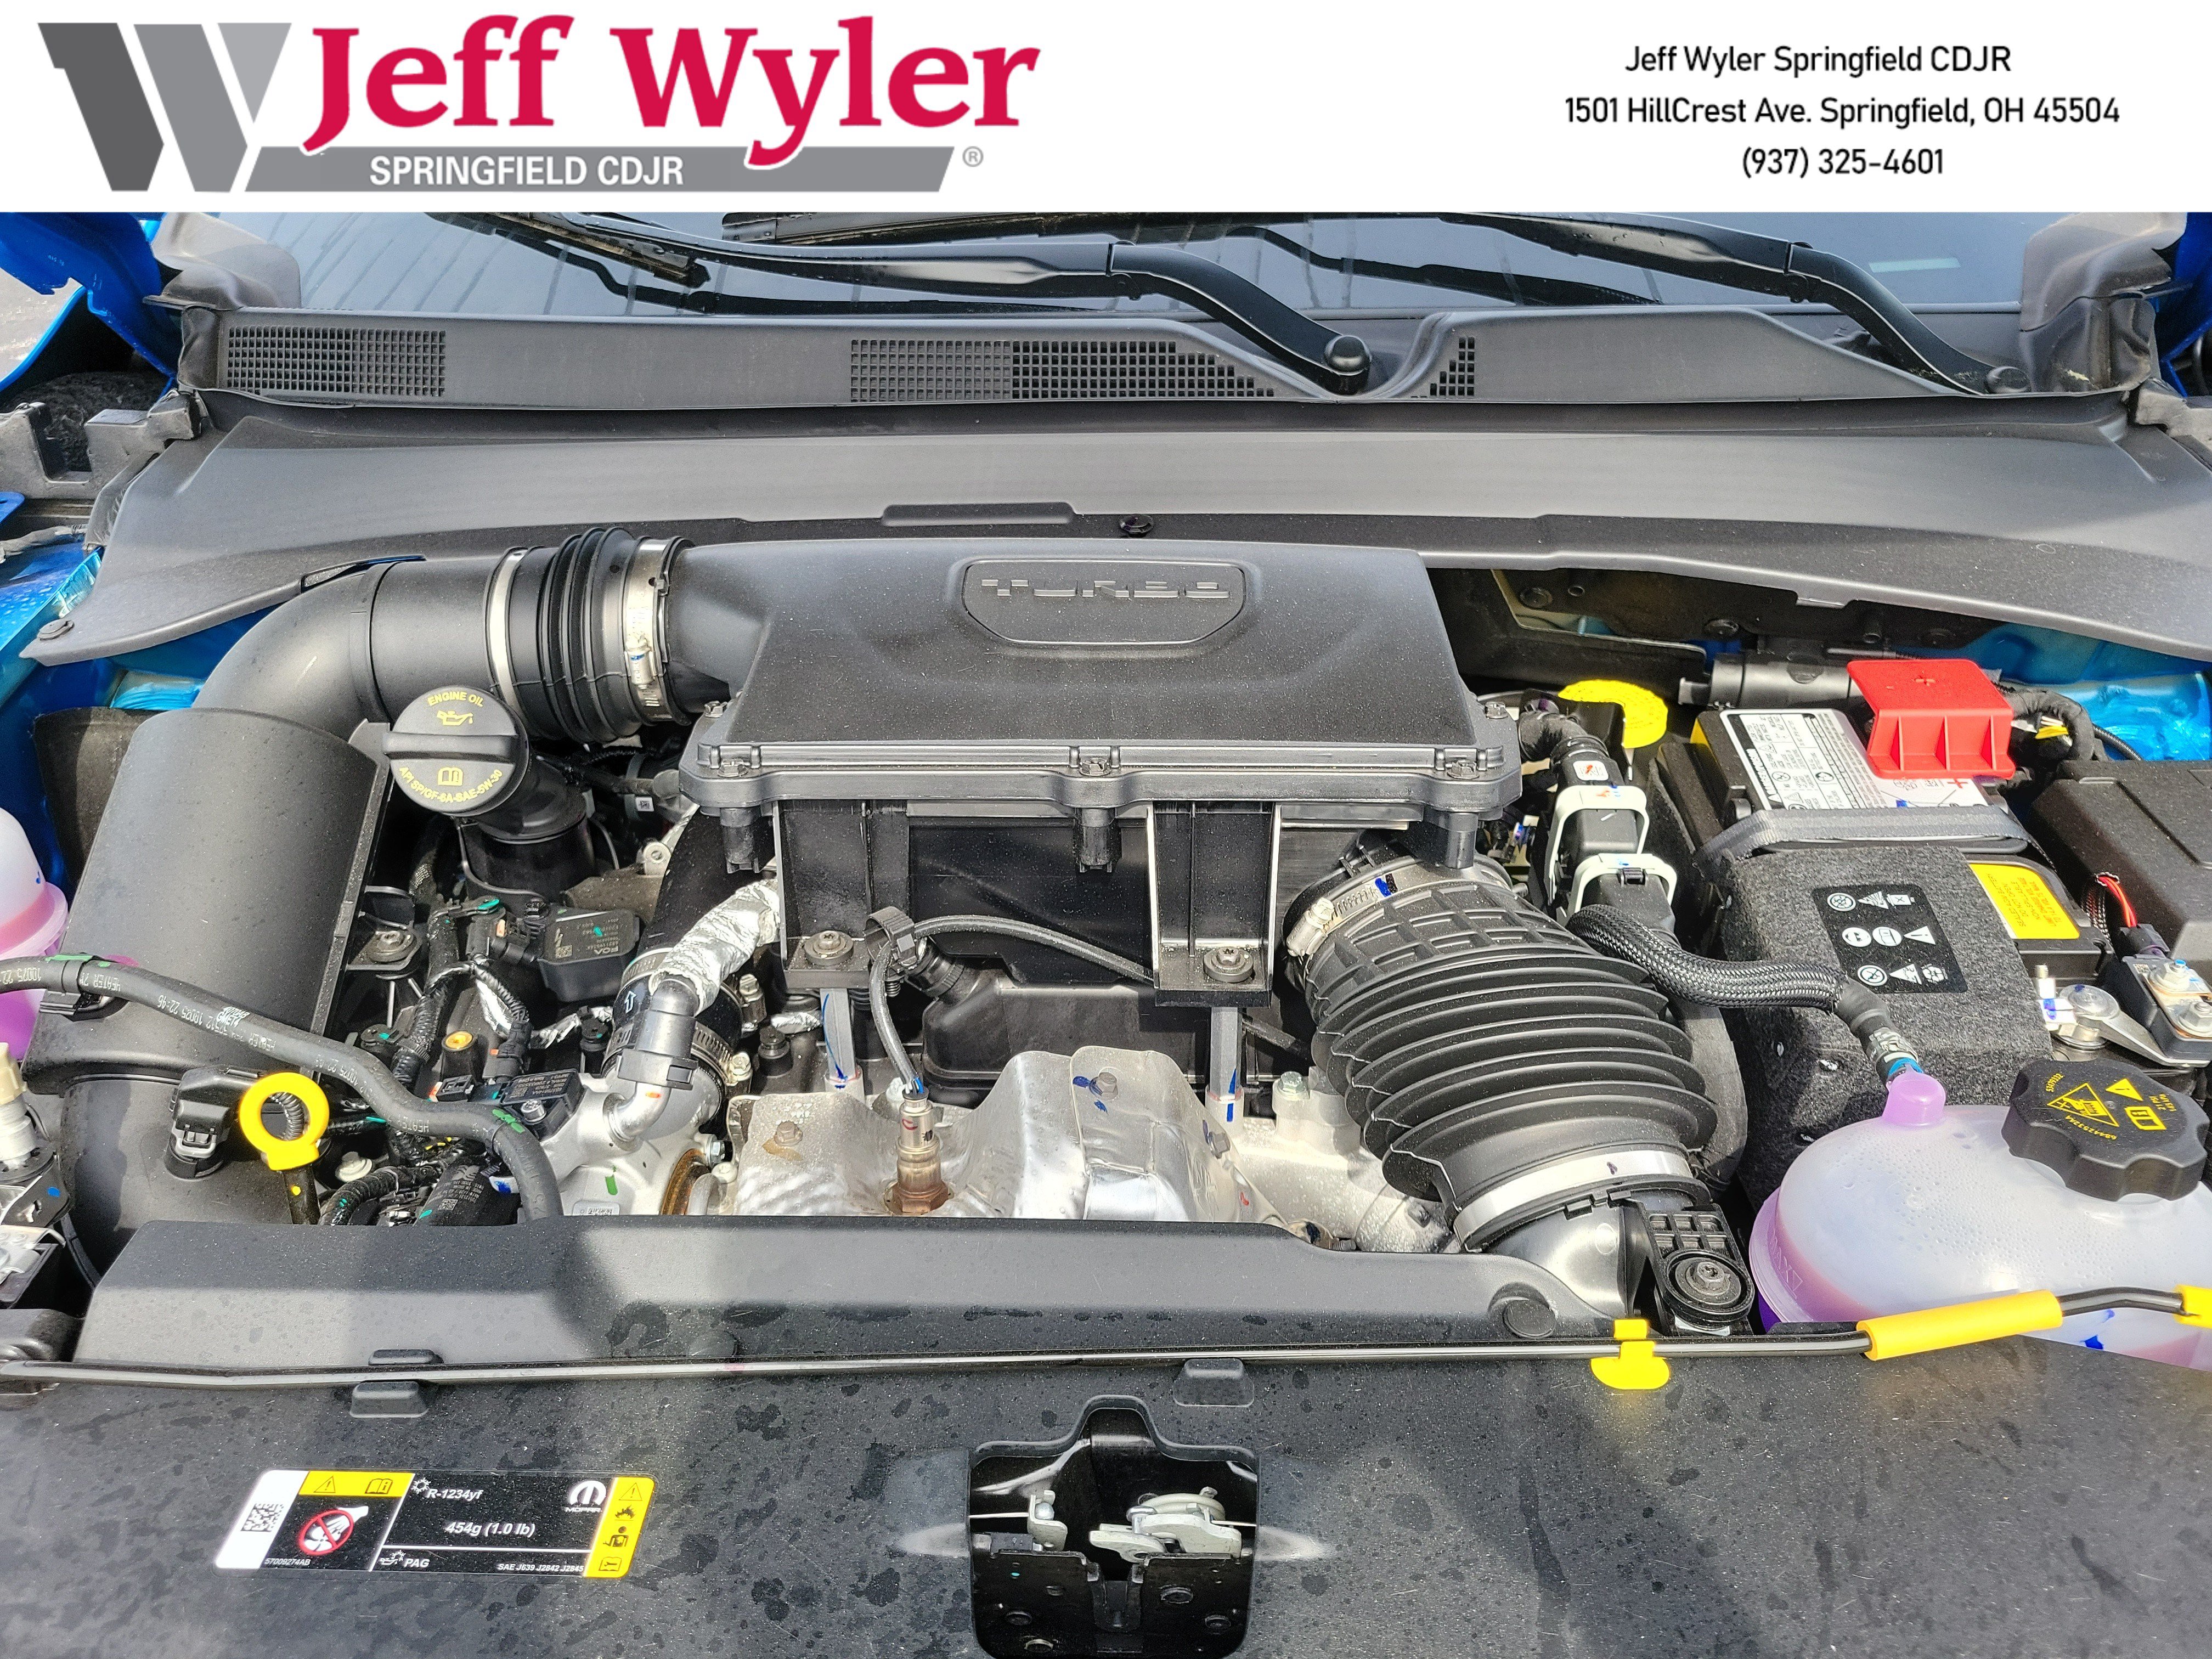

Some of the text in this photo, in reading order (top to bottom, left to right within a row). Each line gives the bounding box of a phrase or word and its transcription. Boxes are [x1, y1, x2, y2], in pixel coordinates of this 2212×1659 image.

[427, 691, 483, 707] ENGINE OIL
[399, 767, 415, 783] API
[1987, 873, 2005, 894] BATTERY
[2012, 898, 2024, 910] NOT
[2008, 906, 2027, 928] SEALED
[427, 1488, 484, 1502] R-1234yf
[445, 1522, 536, 1538] 454g (1.0 lb)
[264, 1558, 311, 1566] 57009274AB
[403, 1558, 431, 1568] PAG
[516, 1564, 535, 1572] J639
[536, 1564, 560, 1572] J2842
[560, 1564, 584, 1573] J2845
